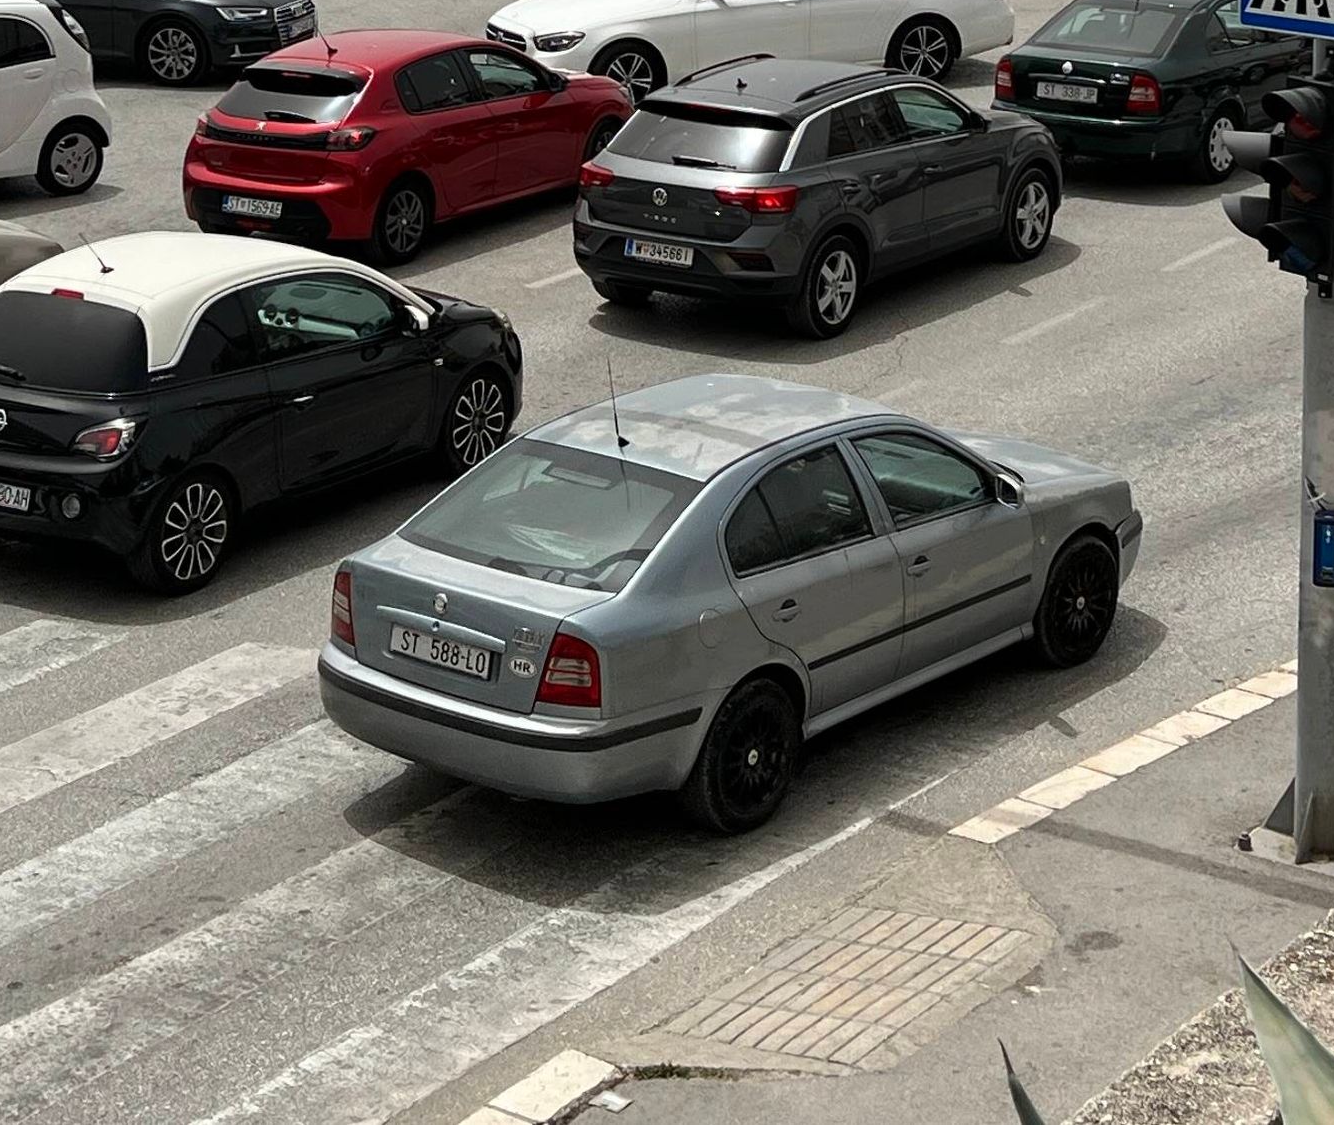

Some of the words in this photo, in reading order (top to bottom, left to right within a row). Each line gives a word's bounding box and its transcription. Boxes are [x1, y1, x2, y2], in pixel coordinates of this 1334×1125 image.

[1043, 84, 1056, 96] ST
[229, 197, 241, 212] ST
[400, 630, 420, 654] ST
[430, 639, 487, 674] 588-LO
[513, 661, 532, 673] HR
